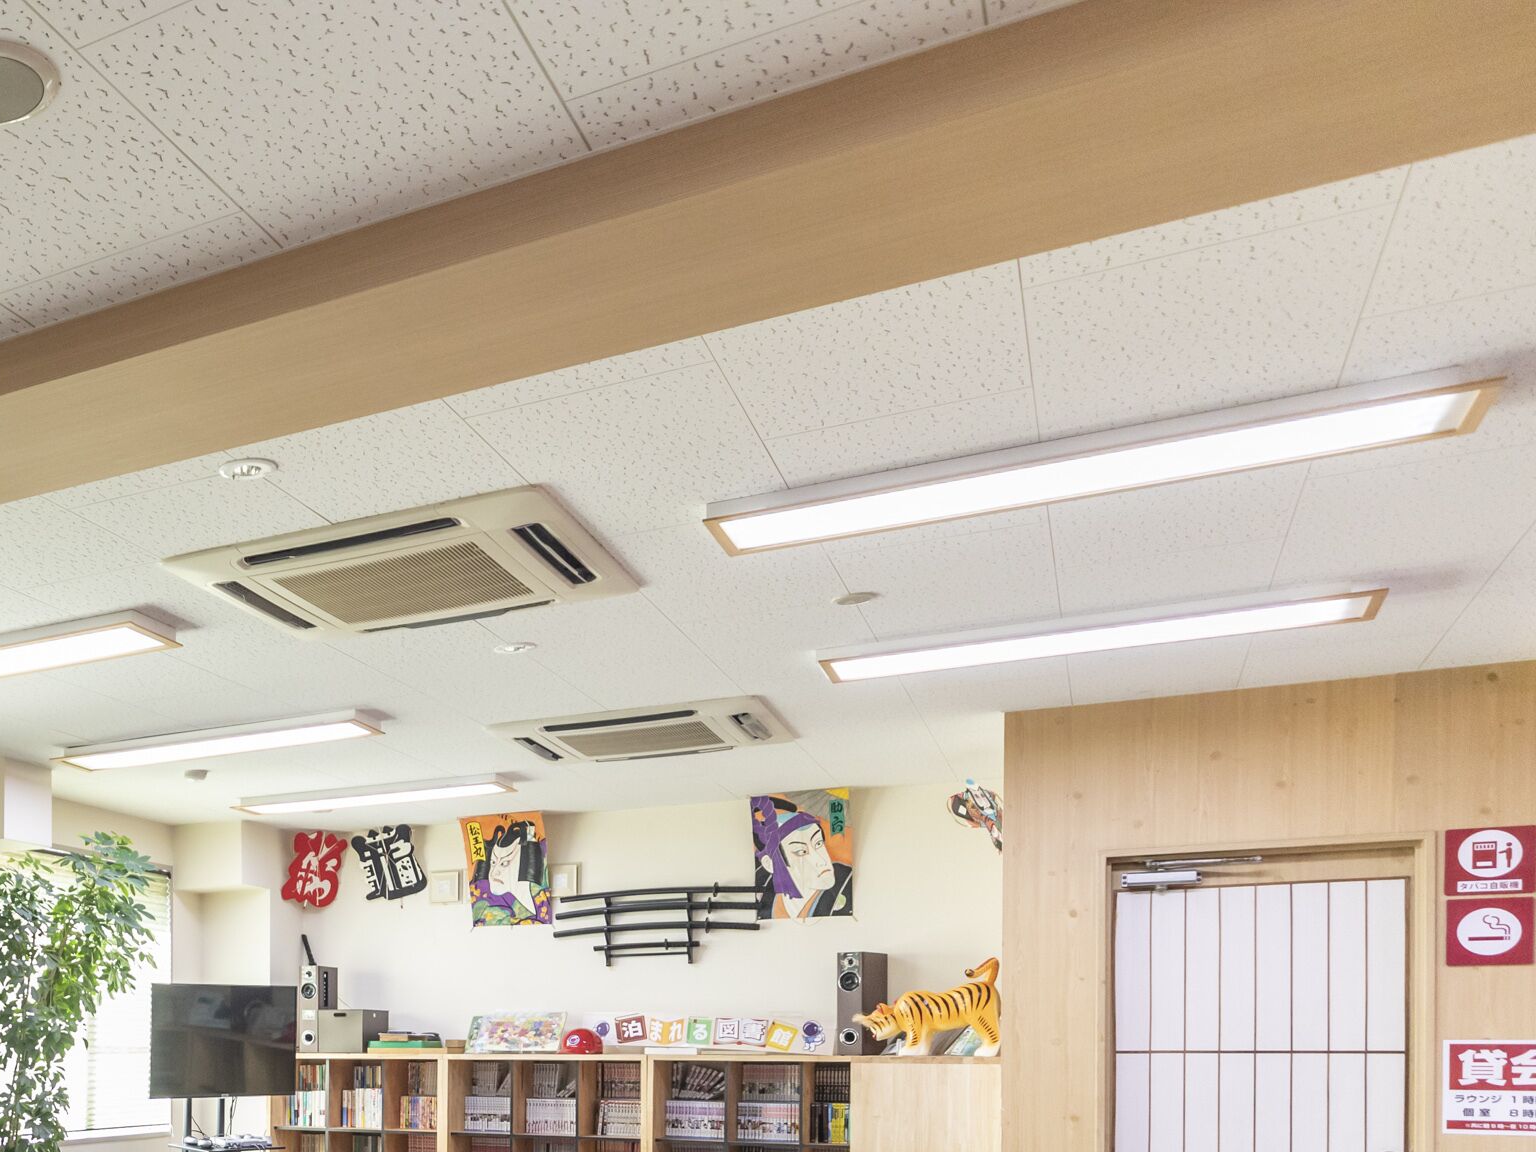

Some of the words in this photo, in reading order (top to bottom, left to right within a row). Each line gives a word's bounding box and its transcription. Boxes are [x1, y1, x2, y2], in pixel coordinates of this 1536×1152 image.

[1460, 881, 1520, 890] タバコ自販機
[1454, 1094, 1502, 1104] ラウンジ
[1511, 1095, 1536, 1105] 1時
[1462, 1107, 1491, 1117] 個室
